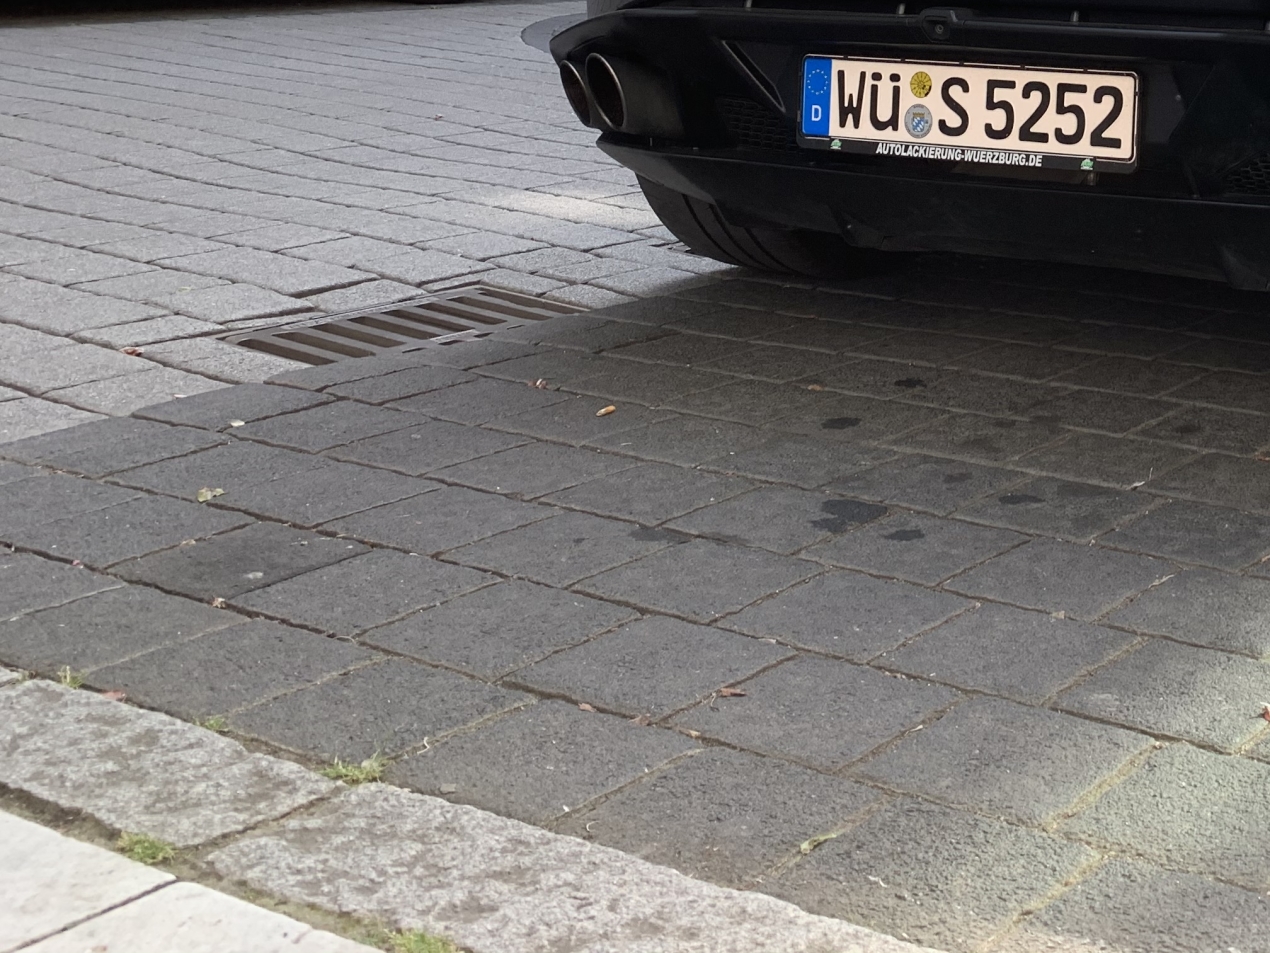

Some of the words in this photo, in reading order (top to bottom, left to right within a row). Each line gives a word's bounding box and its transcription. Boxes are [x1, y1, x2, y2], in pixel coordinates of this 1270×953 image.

[811, 104, 822, 122] D
[837, 69, 901, 132] WÜ
[938, 76, 970, 137] S
[984, 78, 1123, 149] 5252
[875, 141, 1043, 168] AUTOLACKIERUNG-WUERZBURG.DE
